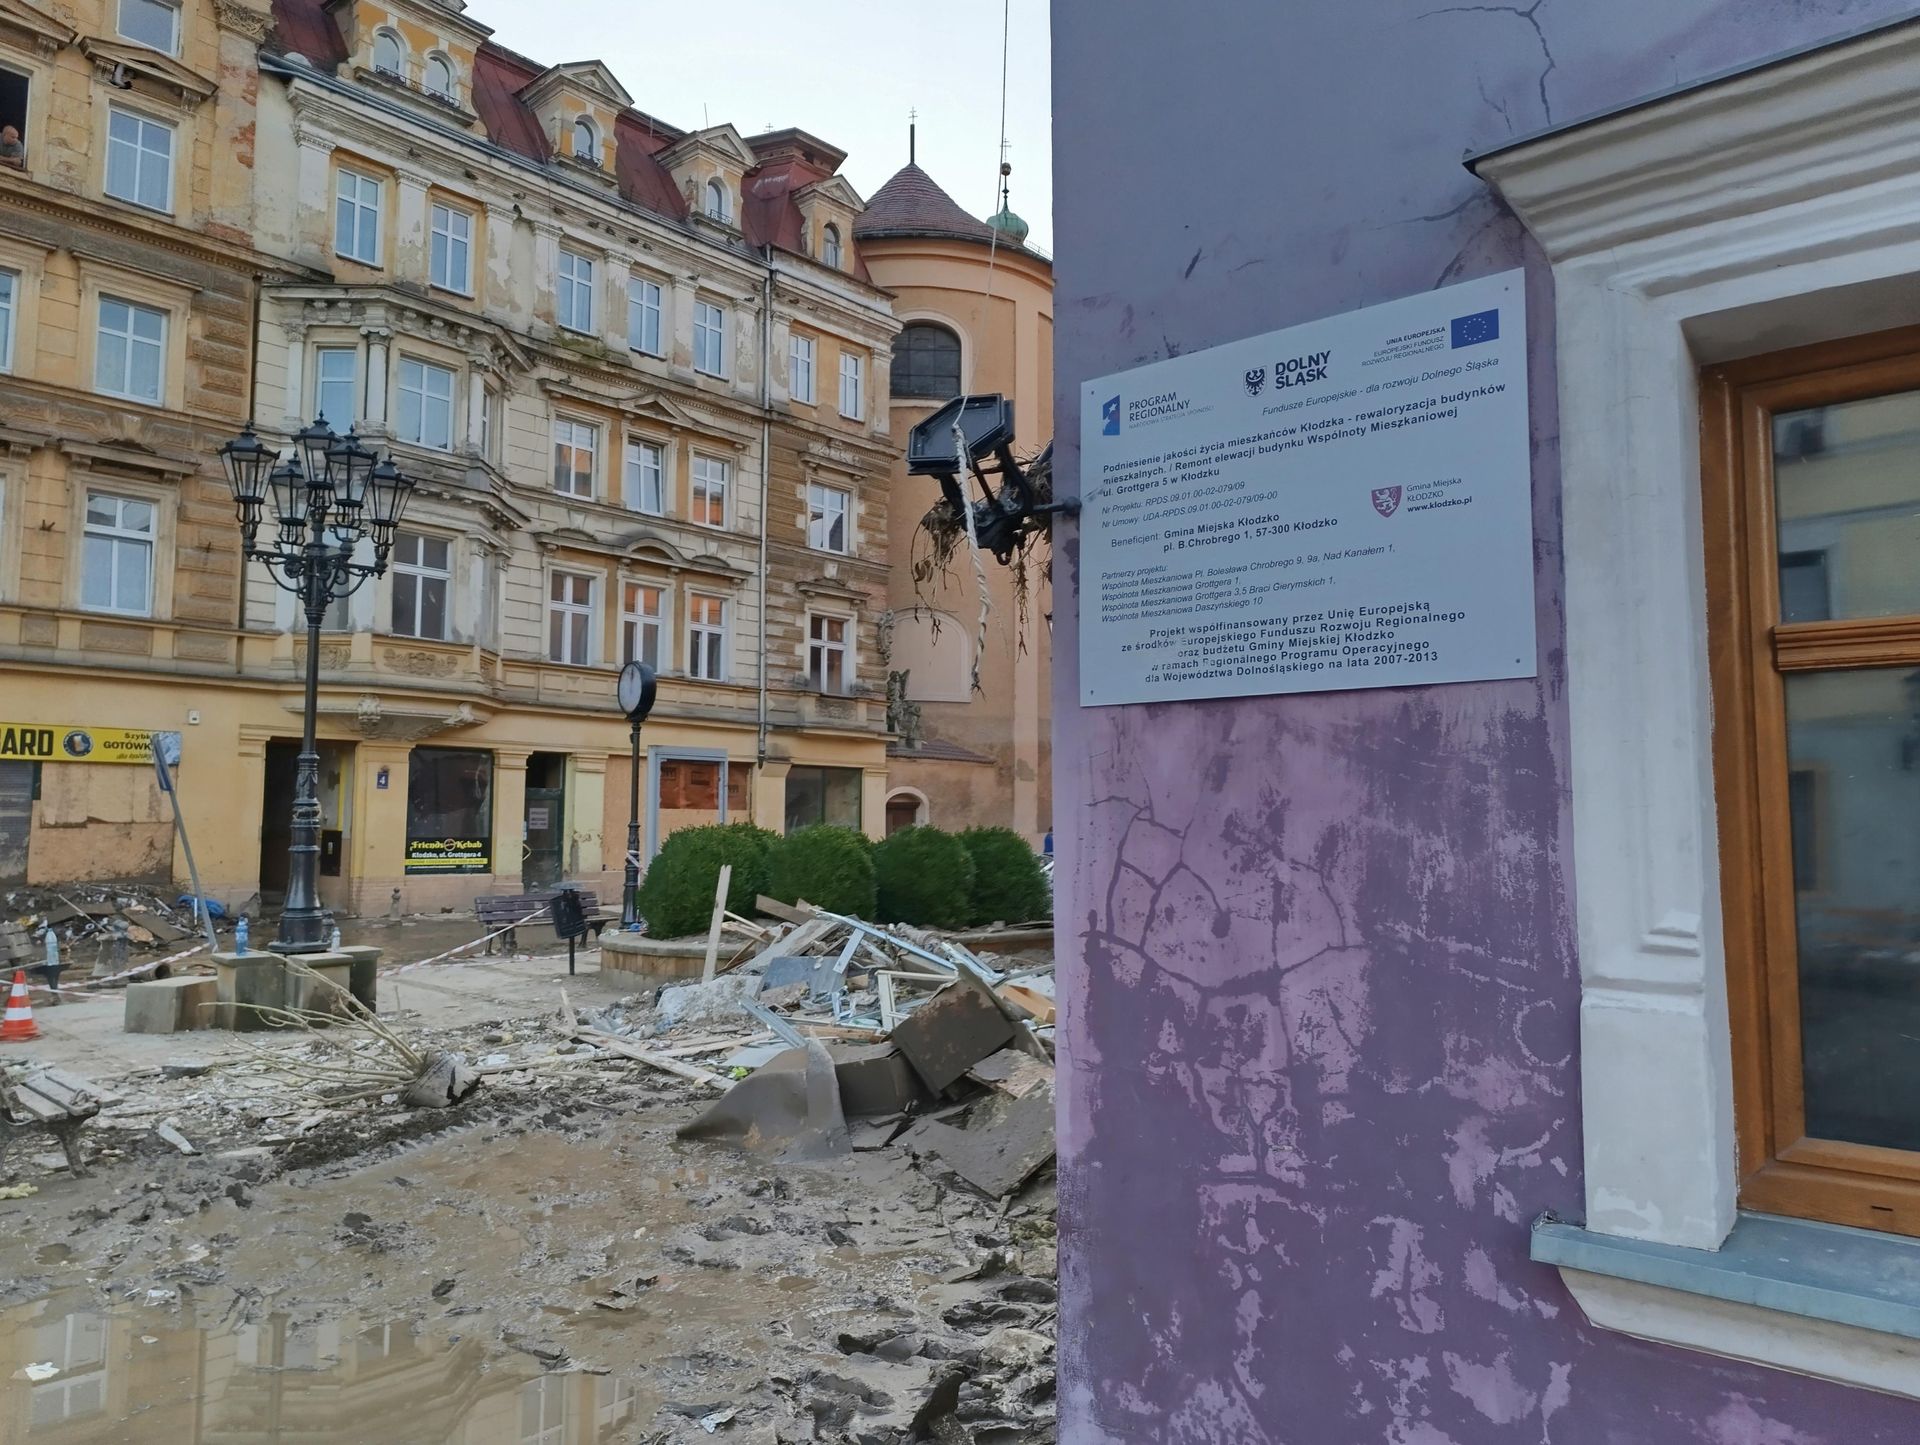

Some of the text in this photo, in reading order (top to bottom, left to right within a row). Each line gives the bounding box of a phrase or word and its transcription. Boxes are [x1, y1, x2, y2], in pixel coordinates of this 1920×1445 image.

[1372, 334, 1445, 358] EUROPEJSKI FUNDUSZ
[1385, 325, 1446, 346] UNIA EUROPEJSKA
[1274, 348, 1332, 376] DOLNY
[1360, 342, 1445, 367] ROZWOJU REGIONALNEGO
[1261, 399, 1304, 417] Fundusze
[1304, 387, 1358, 407] Europejskie
[1364, 382, 1381, 394] dla
[1380, 374, 1420, 391] rozwoju
[1420, 365, 1463, 382] Dolnego
[1464, 357, 1500, 372] Śląska
[1274, 363, 1329, 390] ŚLĄSK
[1128, 390, 1177, 412] PROGRAM
[1128, 398, 1191, 423] REGIONALNY
[1102, 454, 1161, 474] Podniesienie
[1161, 445, 1197, 464] jakości
[1198, 440, 1225, 455] życia
[1226, 425, 1298, 448] mieszkańców
[1299, 416, 1345, 433] Kłodzka
[1354, 396, 1437, 423] rewaloryzacja
[1439, 382, 1506, 405] budynków
[1174, 455, 1213, 472] Remont
[1213, 445, 1256, 464] elewacji
[1257, 438, 1304, 455] budynku
[1306, 425, 1367, 445] Wspólnoty
[1369, 405, 1458, 433] Mieszkaniowej
[1115, 479, 1160, 495] Grottgera
[1161, 476, 1168, 486] 5
[1179, 467, 1220, 483] Kłodzku
[1405, 476, 1464, 493] Gmina Miejska
[1405, 494, 1473, 513] www.klodzko.pl
[1406, 488, 1445, 503] KŁODZKO
[1100, 505, 1112, 516] Nr
[1100, 519, 1112, 529] Nr
[1162, 526, 1195, 540] Gmina
[1196, 519, 1235, 534] Miejska
[1236, 512, 1280, 528] Kłodzko
[1162, 541, 1176, 554] pl.
[1255, 522, 1290, 538] 57-300
[1292, 516, 1338, 532] Kłodzko
[1100, 578, 1140, 592] Wspólnota
[1139, 571, 1194, 586] Mieszkaniowa
[1248, 557, 1295, 571] Chrobrego
[1321, 549, 1343, 561] Nad
[1100, 569, 1137, 581] Partnerzy
[1100, 589, 1140, 602] Wspólnota
[1139, 582, 1194, 597] Mieszkaniowa
[1193, 577, 1233, 590] Grottgera
[1100, 600, 1140, 613] Wspólnota
[1139, 593, 1194, 608] Mieszkaniowa
[1194, 589, 1233, 601] Grottgera
[1247, 582, 1271, 595] Braci
[1271, 576, 1326, 592] Gierymskich
[1100, 611, 1140, 624] Wspólnota
[1139, 605, 1194, 619] Mieszkaniowa
[1252, 595, 1264, 606] 10
[1148, 600, 1431, 639] Projekt współfinansowany przez Unię Europejską
[1120, 643, 1133, 653] ze
[1134, 637, 1177, 651] środków
[1259, 625, 1316, 639] Funduszu
[1319, 618, 1372, 633] Rozwoju
[1375, 610, 1466, 629] Regionalnego
[1176, 628, 1395, 658] oraz budżetu Gminy Miejskiej Kłodzko
[1144, 650, 1439, 683] dla Województwa Dolnośląskiego na lata 2007-2013
[1160, 658, 1199, 671] ramach
[1280, 648, 1338, 662] Programu
[1341, 640, 1430, 657] Operacyjnego
[0, 727, 55, 756] ARD
[103, 739, 153, 751] GOTÓWK
[379, 775, 386, 785] 4
[410, 841, 482, 851] Friends Kebab
